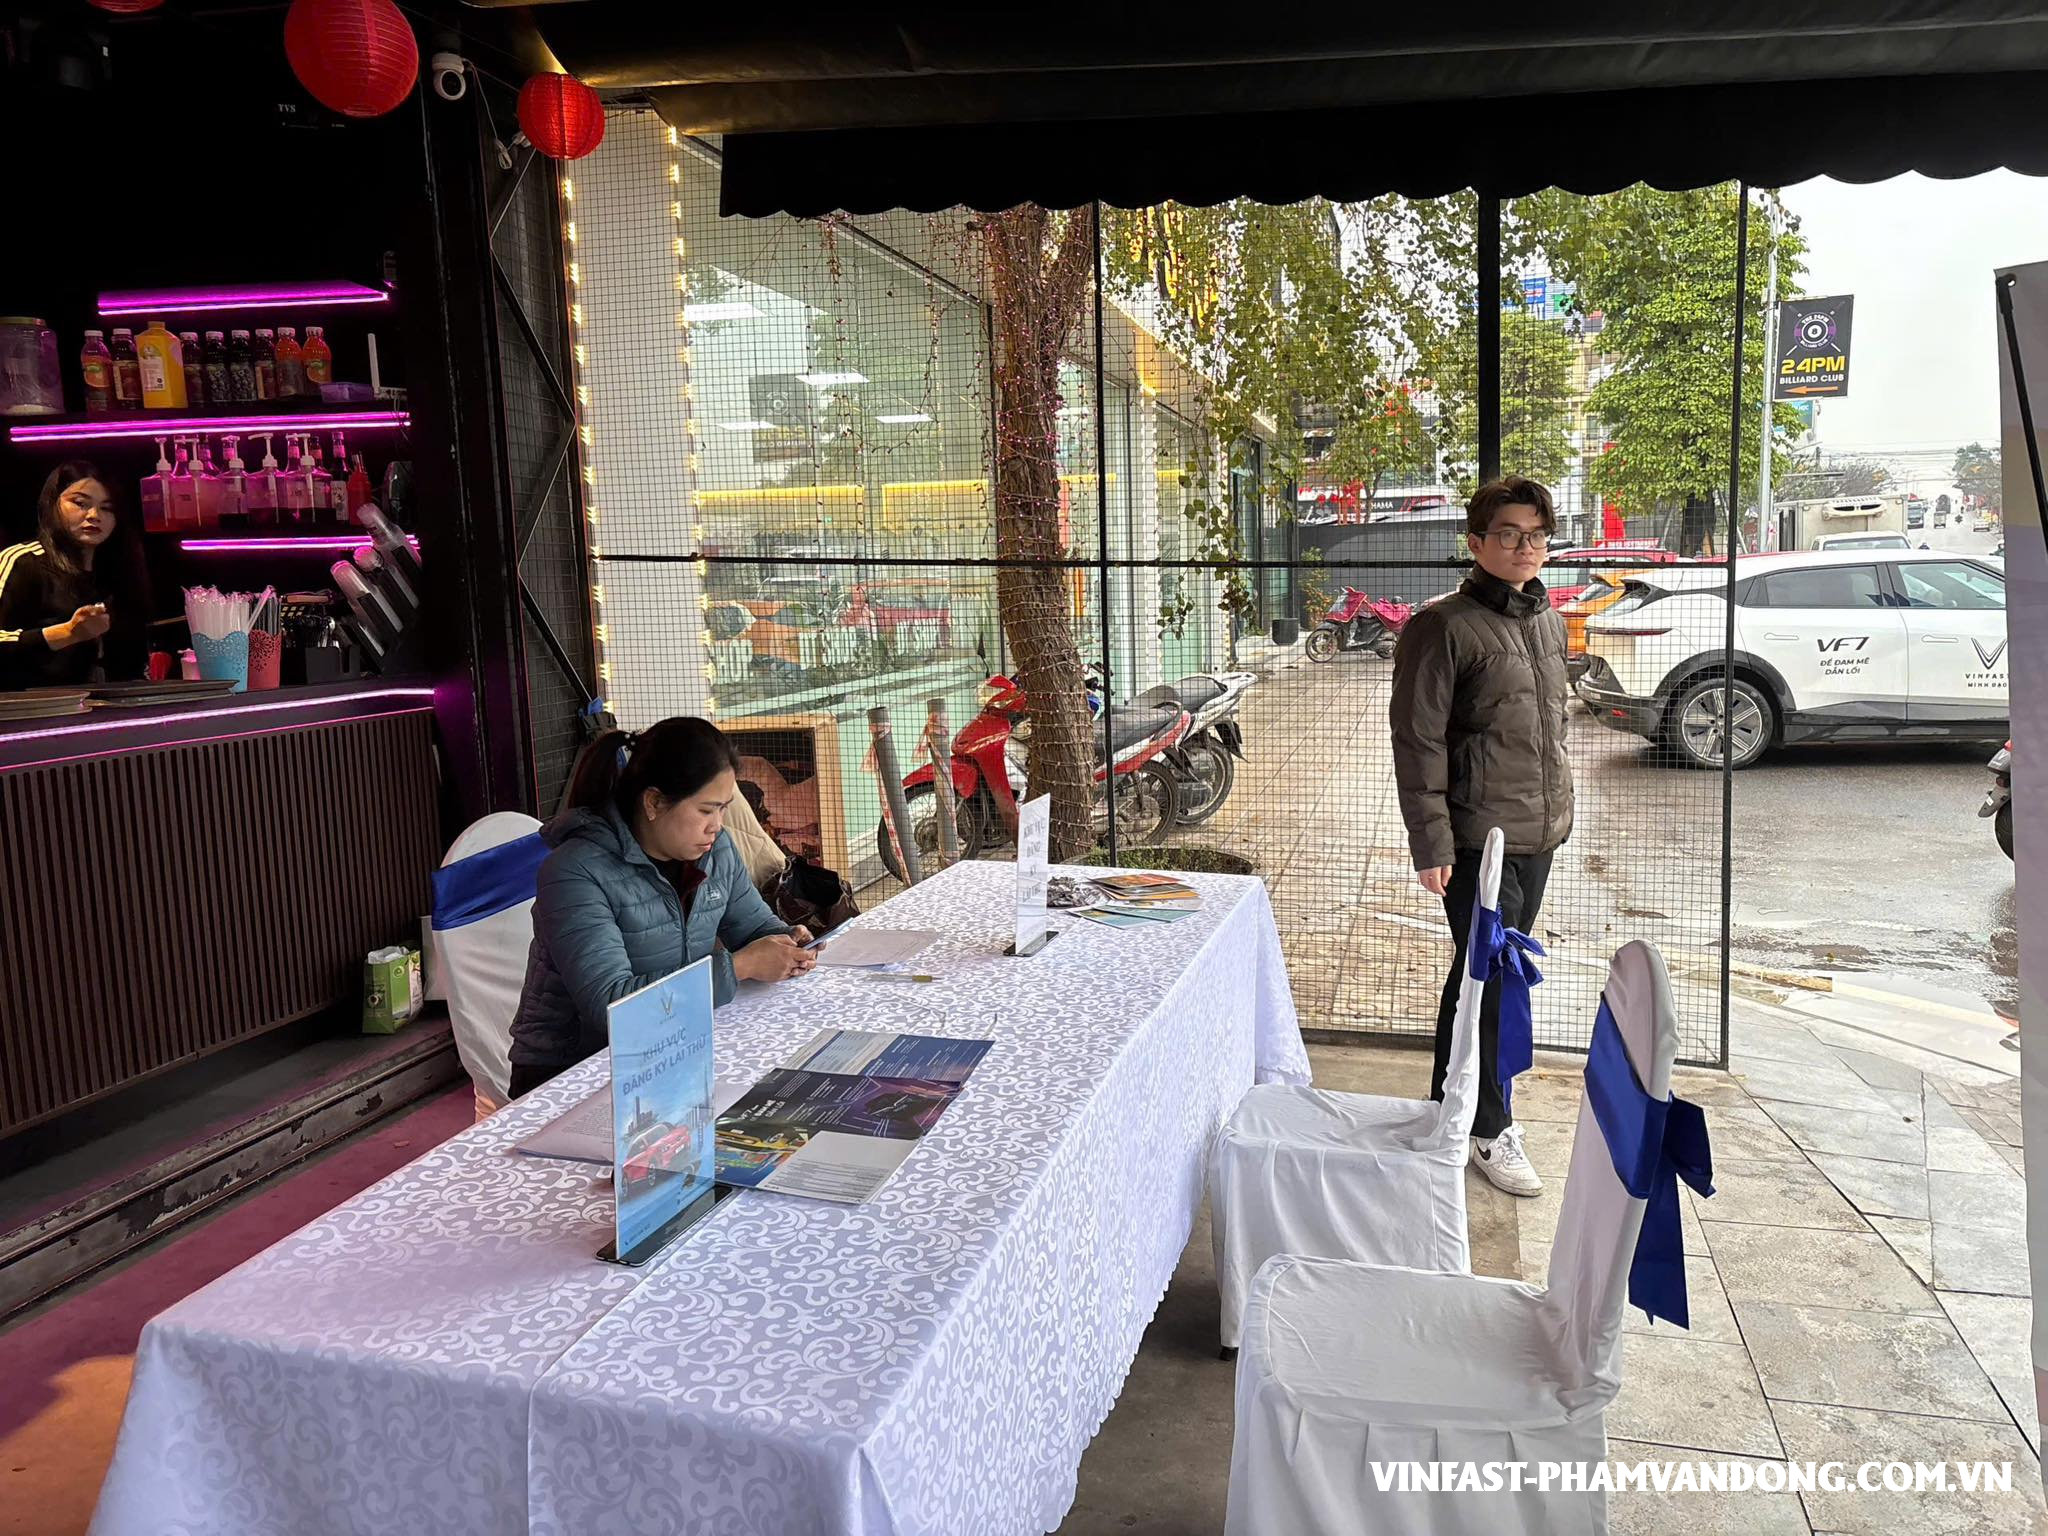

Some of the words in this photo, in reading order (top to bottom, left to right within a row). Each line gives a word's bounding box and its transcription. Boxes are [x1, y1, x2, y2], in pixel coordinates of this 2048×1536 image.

[1781, 356, 1846, 375] 24PM
[1779, 375, 1818, 385] BILLIARD
[1820, 374, 1845, 382] CLUB
[1817, 637, 1870, 652] VF7
[642, 1040, 665, 1063] KHU
